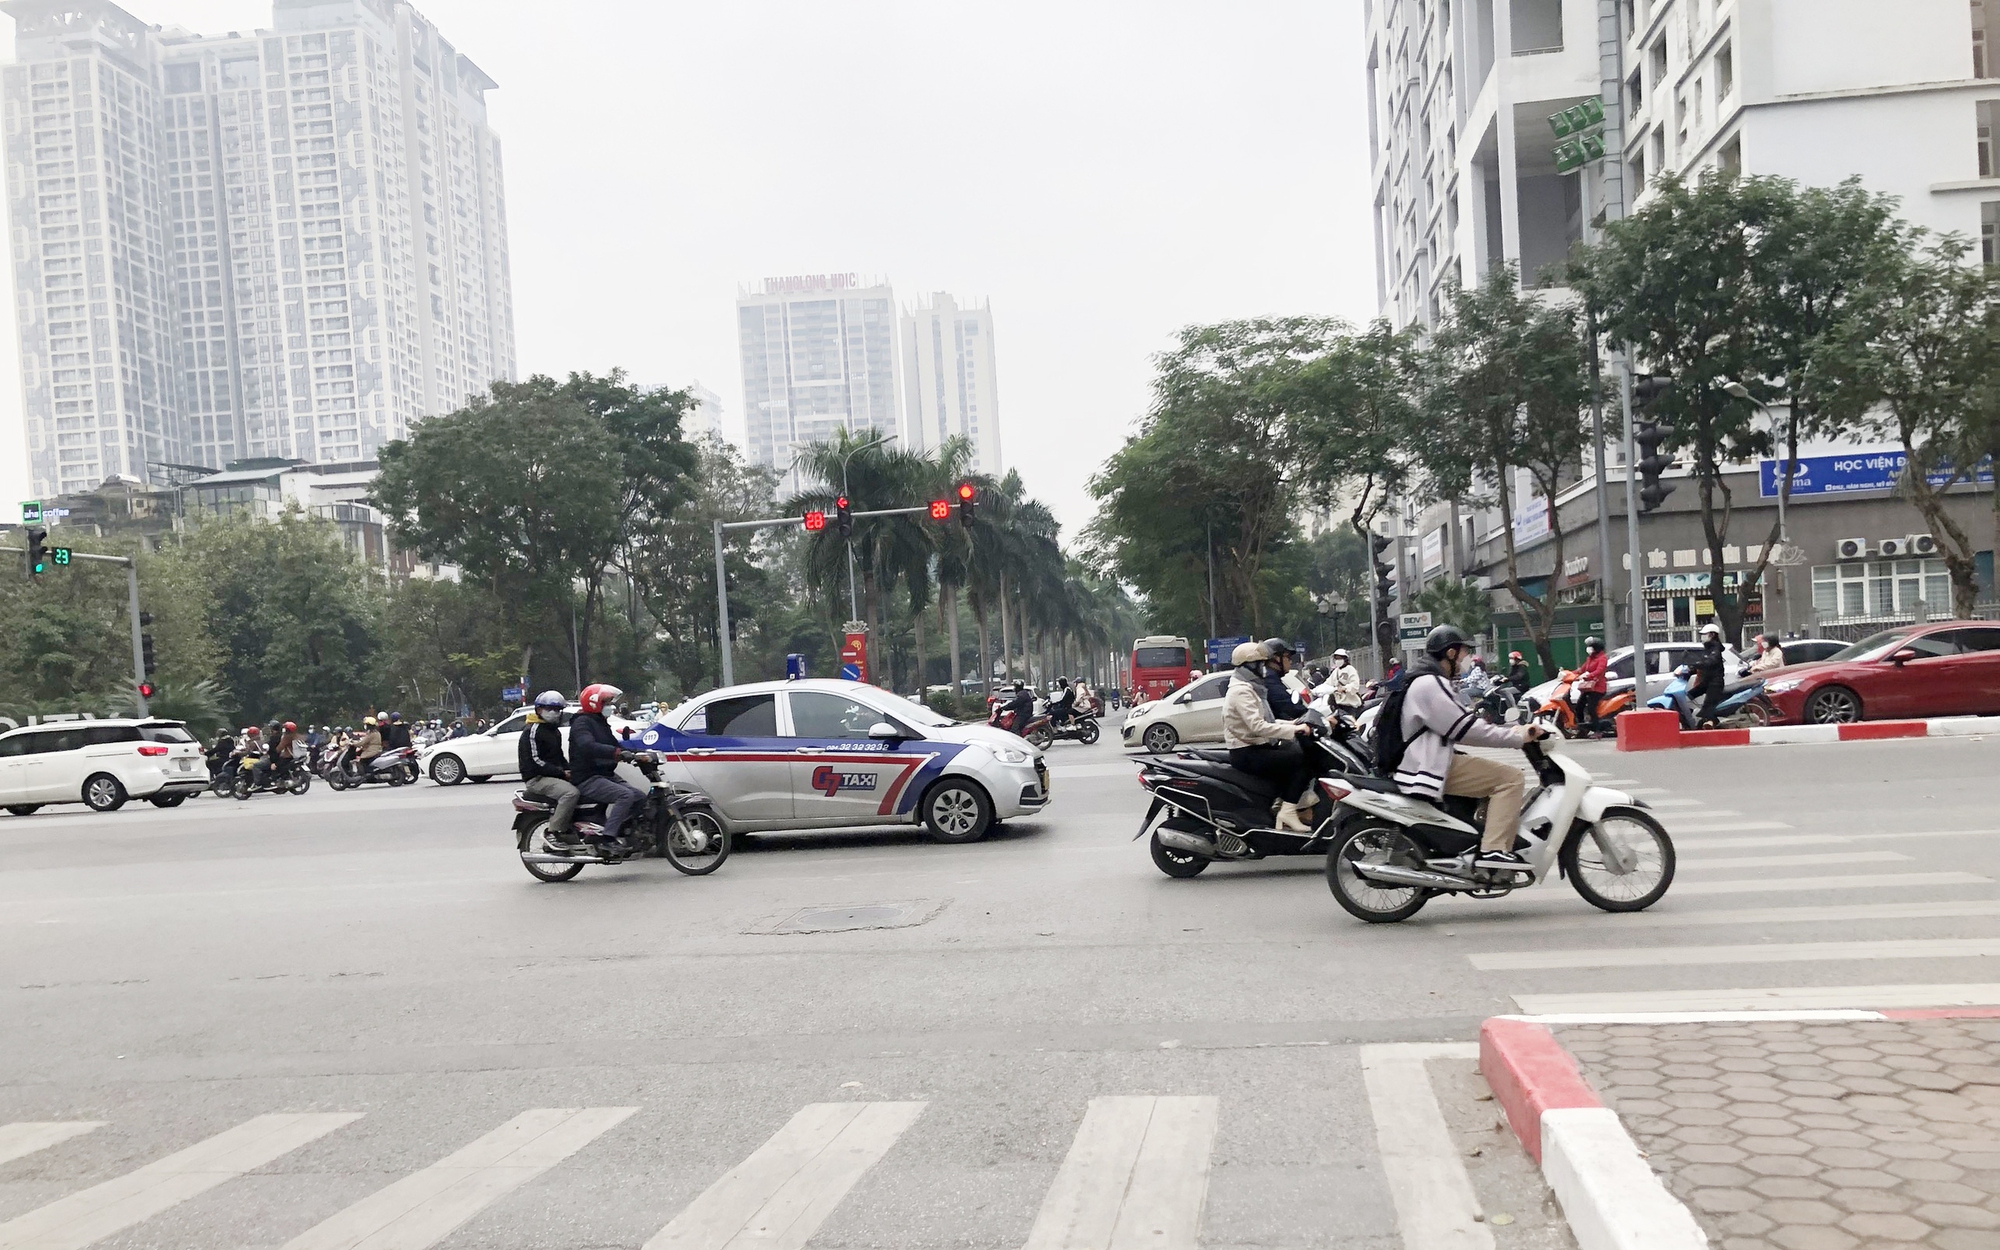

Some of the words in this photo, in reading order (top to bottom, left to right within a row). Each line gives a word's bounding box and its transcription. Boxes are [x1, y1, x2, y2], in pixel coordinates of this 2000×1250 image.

[764, 274, 826, 292] THANGLONG
[831, 272, 856, 288] UDIC
[1834, 459, 1863, 473] HỌC
[1865, 456, 1894, 471] VIỆN
[24, 509, 39, 519] aha
[42, 508, 70, 517] coffee
[932, 502, 948, 518] 28
[806, 513, 824, 529] 28
[55, 548, 69, 564] 23
[843, 774, 877, 786] TAXI
